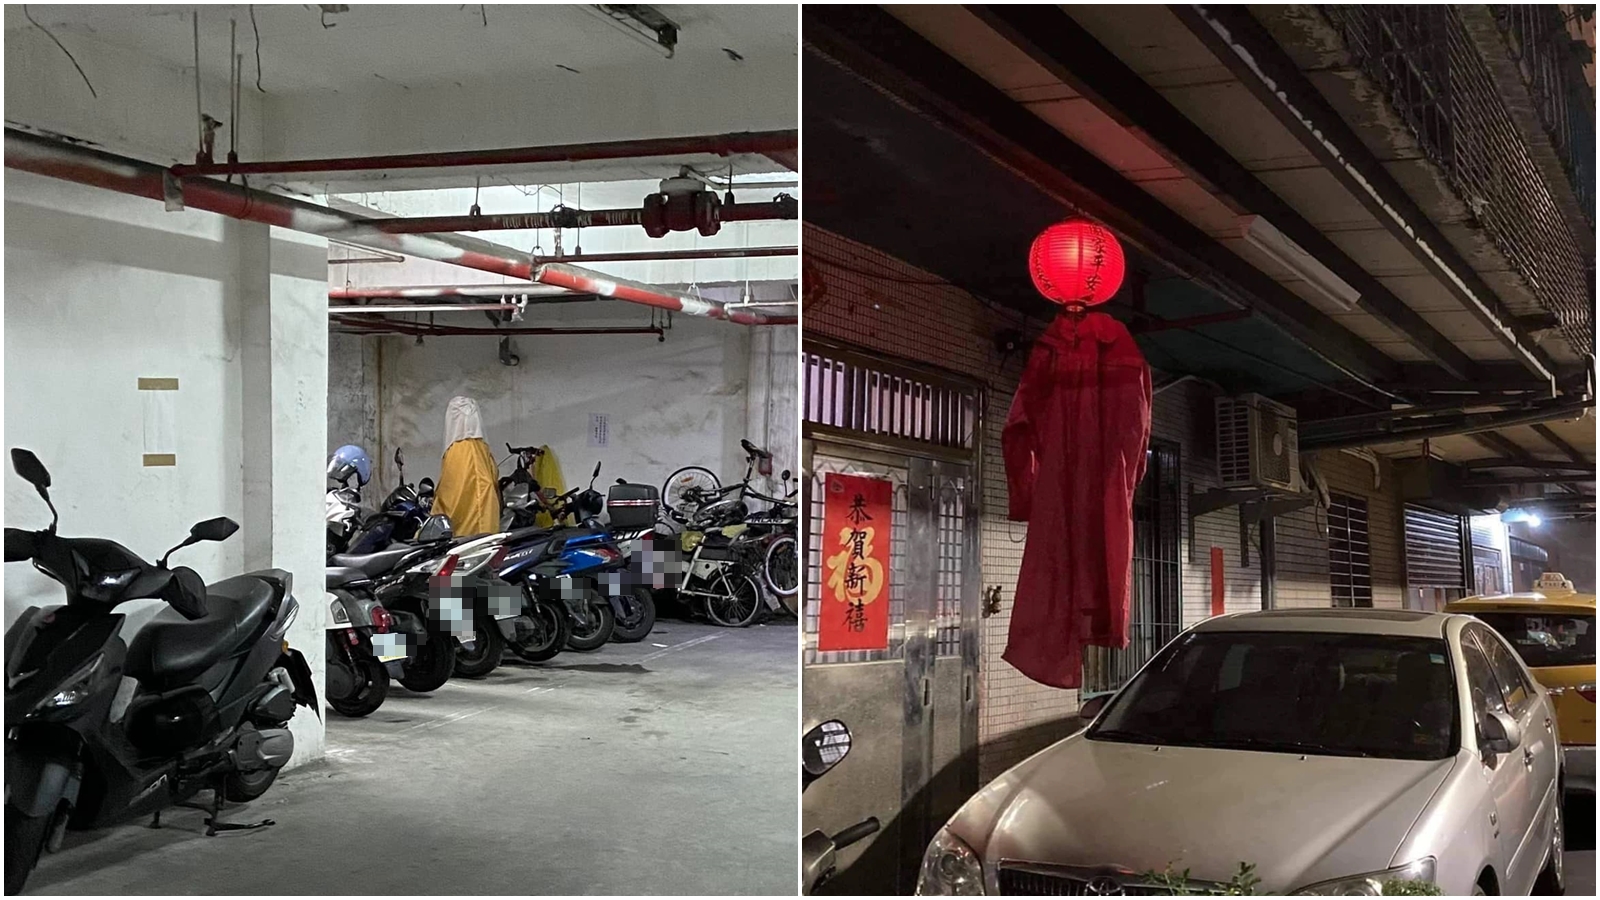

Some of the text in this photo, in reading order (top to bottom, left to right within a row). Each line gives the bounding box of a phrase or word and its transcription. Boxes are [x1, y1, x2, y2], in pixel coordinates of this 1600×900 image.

[827, 526, 883, 605] 福
[842, 494, 873, 632] 恭賀新禧
